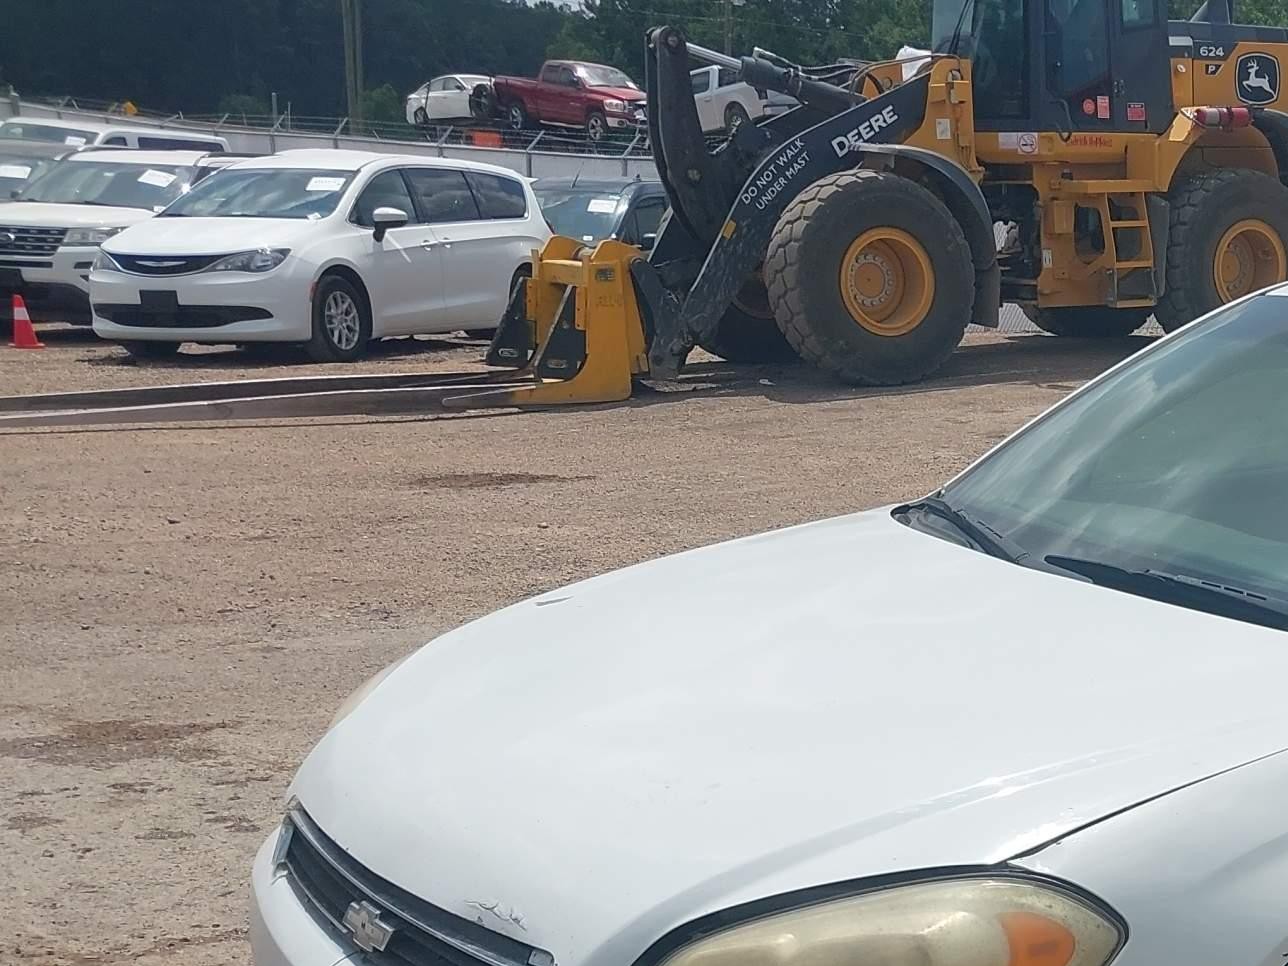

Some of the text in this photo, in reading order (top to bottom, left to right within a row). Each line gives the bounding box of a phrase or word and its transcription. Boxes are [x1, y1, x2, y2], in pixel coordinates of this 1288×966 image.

[1199, 46, 1225, 57] 624
[1207, 64, 1216, 74] P
[831, 104, 899, 158] DEERE
[740, 138, 806, 205] DO NOT WALK
[755, 151, 812, 211] UNDER MAST
